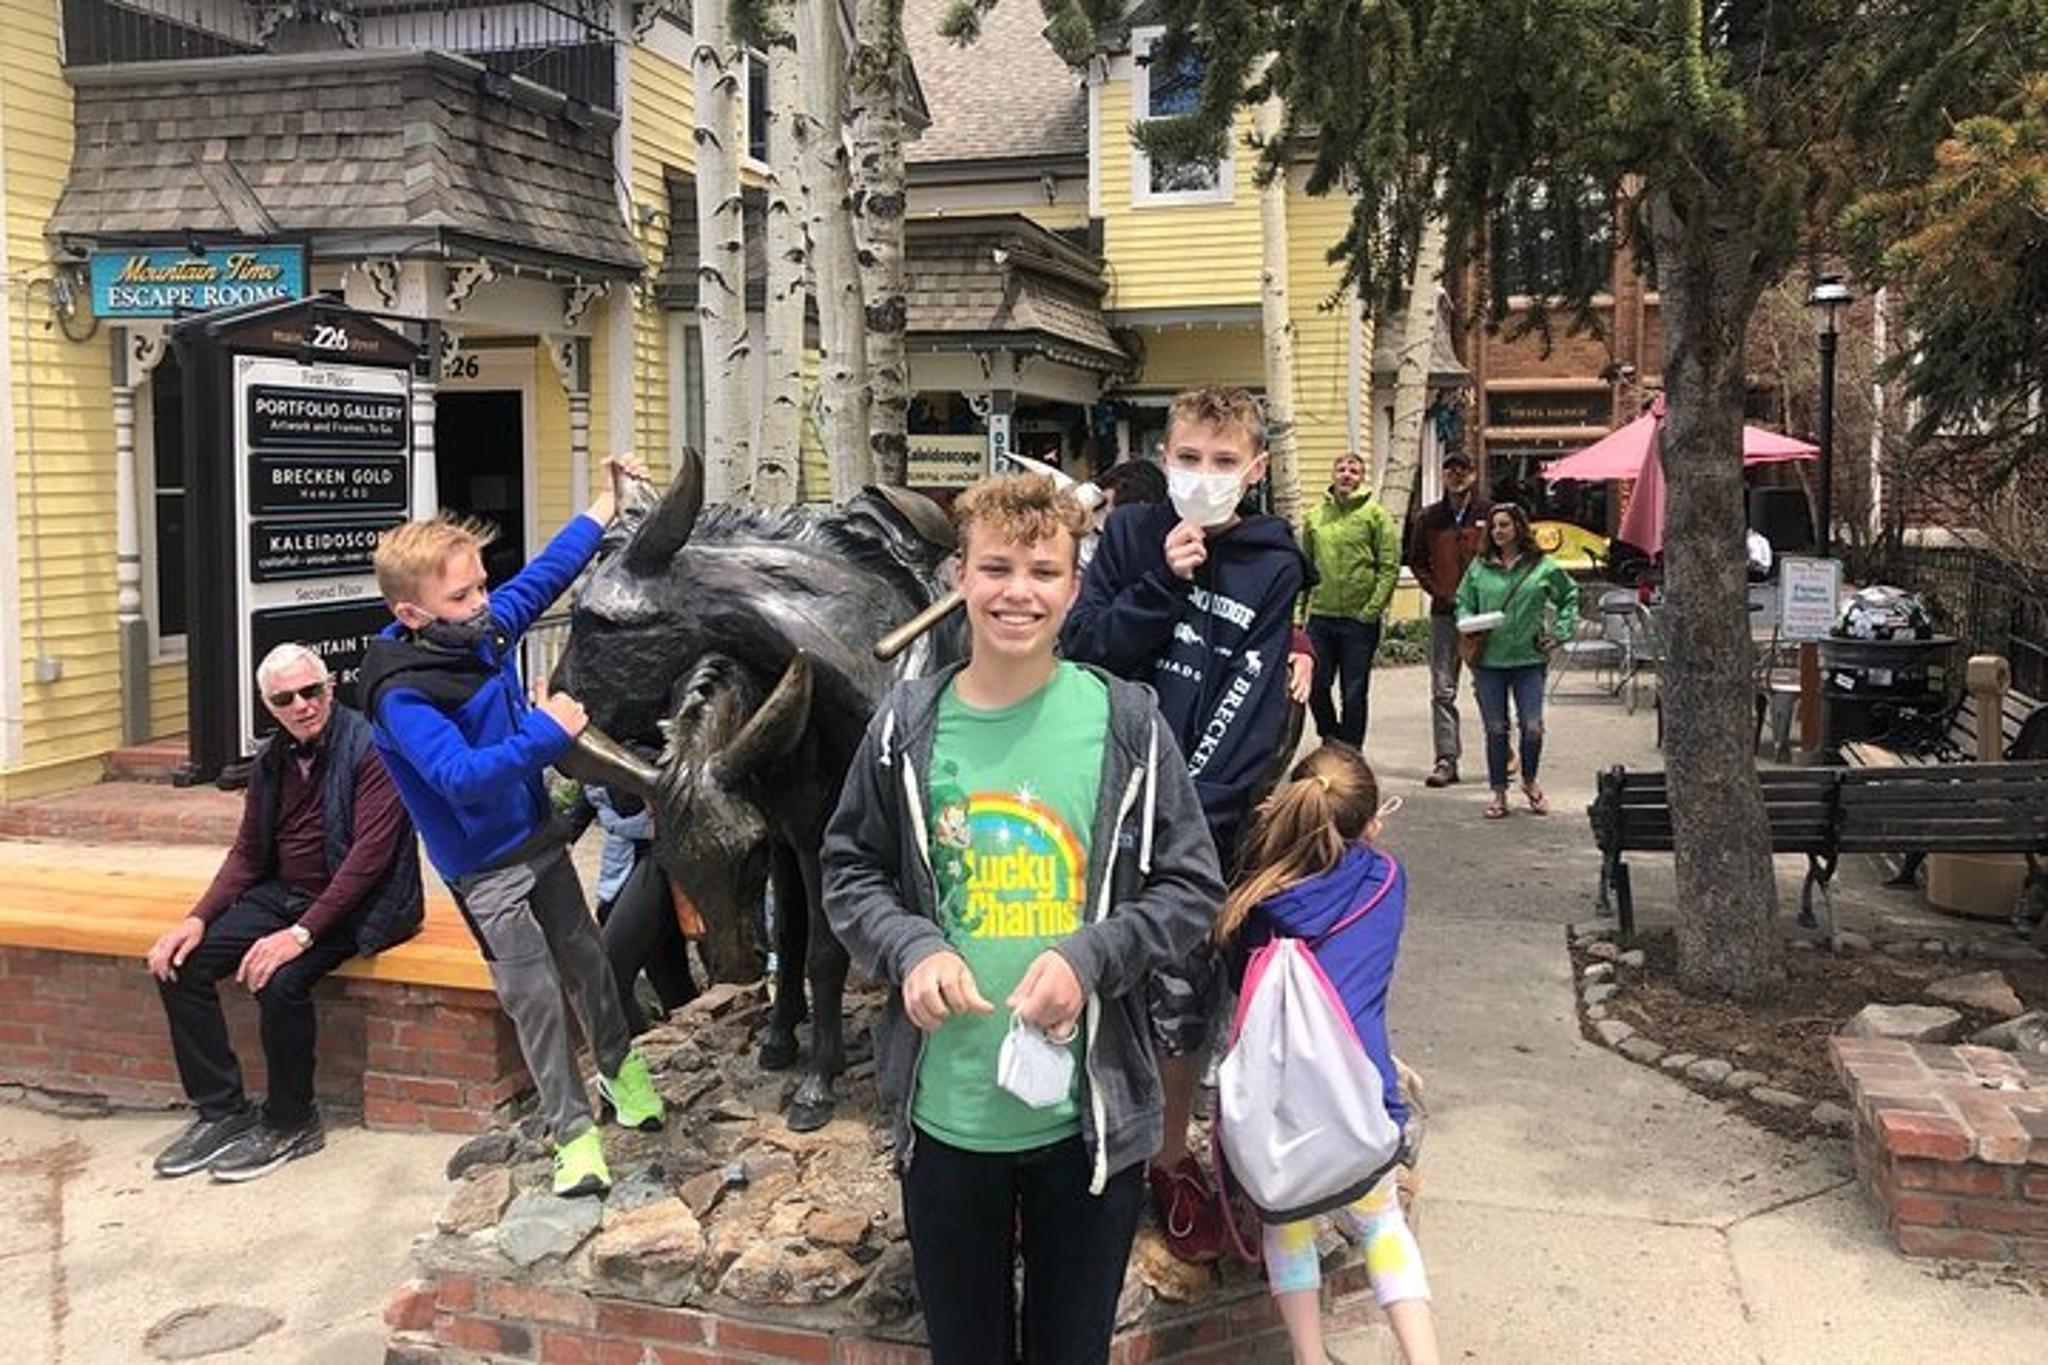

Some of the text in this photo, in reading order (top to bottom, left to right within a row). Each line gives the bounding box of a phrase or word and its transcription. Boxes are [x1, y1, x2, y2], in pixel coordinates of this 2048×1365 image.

[112, 252, 282, 283] Mountain Time
[108, 285, 288, 308] ESCAPE ROOMS
[314, 323, 349, 350] 226
[255, 398, 403, 419] PORTFOLIO GALLERY
[271, 468, 394, 485] BRECKEN GOLD
[965, 844, 1057, 899] Lucky
[964, 890, 1080, 937] Charms
